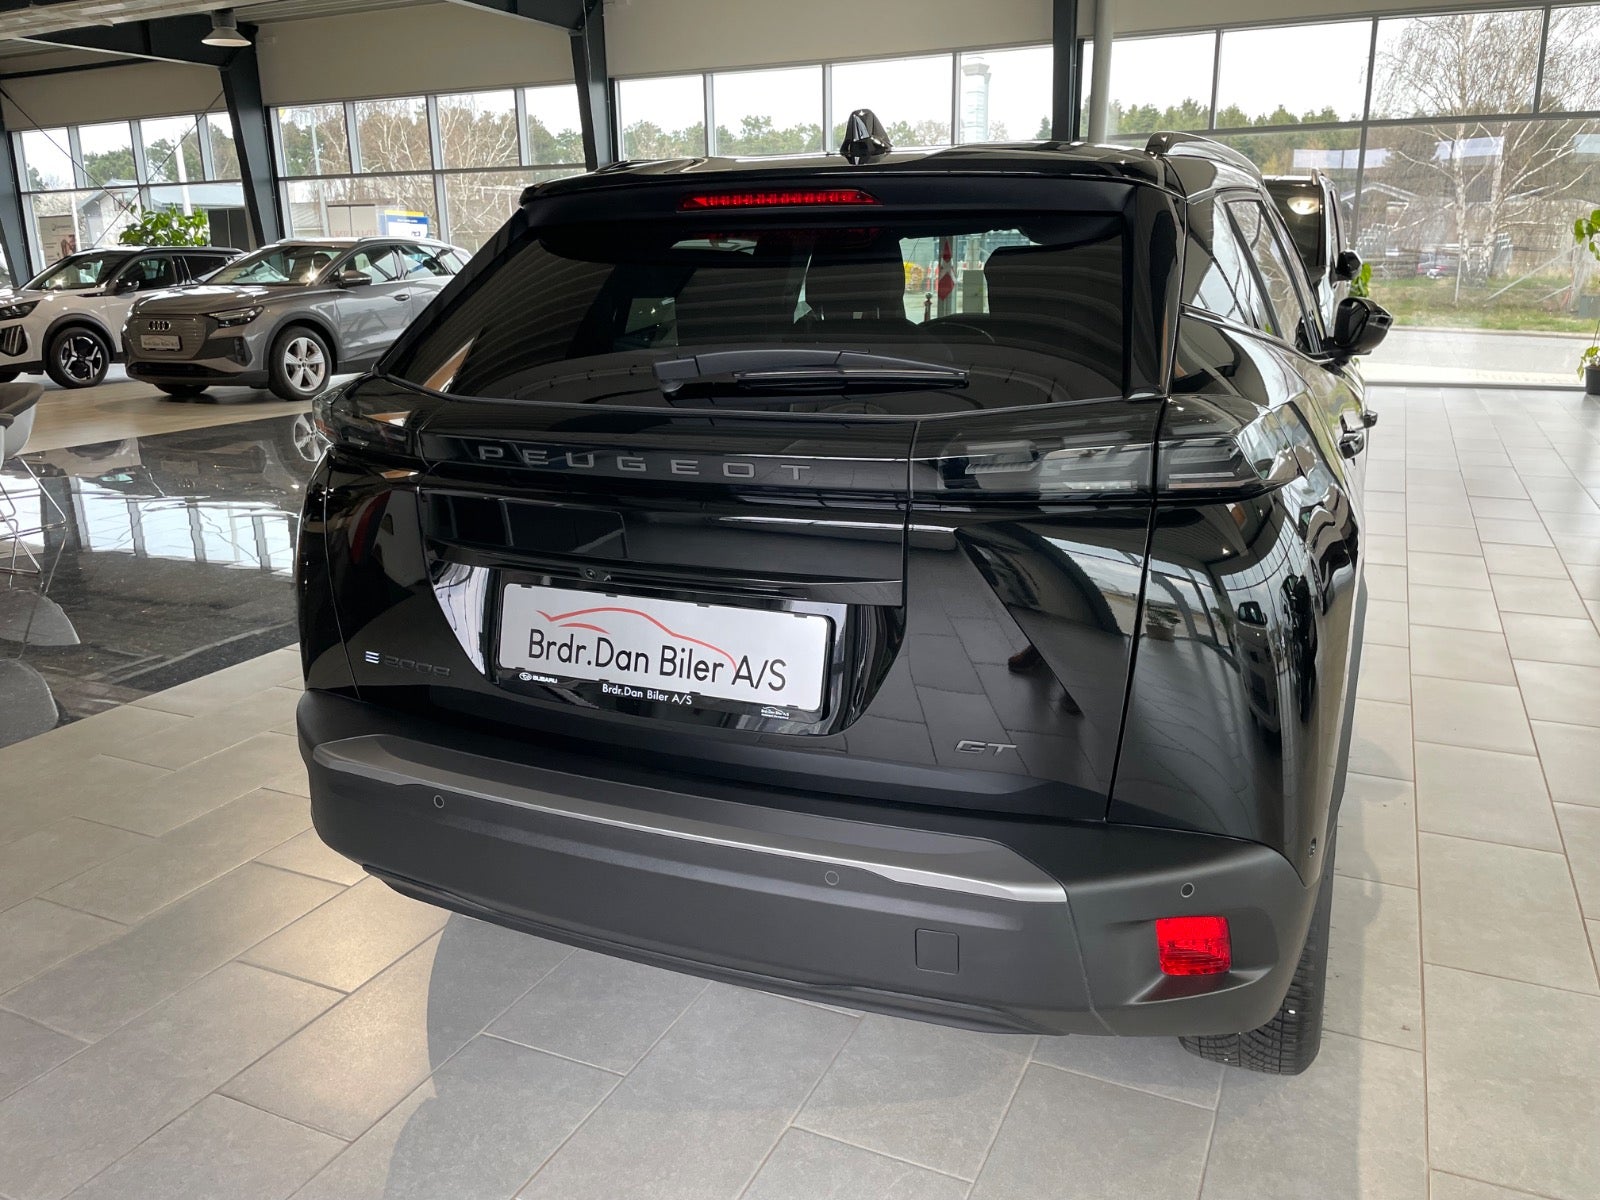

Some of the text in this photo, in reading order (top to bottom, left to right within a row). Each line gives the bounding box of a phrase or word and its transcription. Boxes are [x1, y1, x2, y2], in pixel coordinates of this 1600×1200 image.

[478, 445, 811, 481] PEUGEOT
[528, 628, 787, 692] Brdr.Dan Biler A/S
[602, 683, 693, 706] Brdr.Dan Biler A/S
[954, 739, 1017, 757] GT
